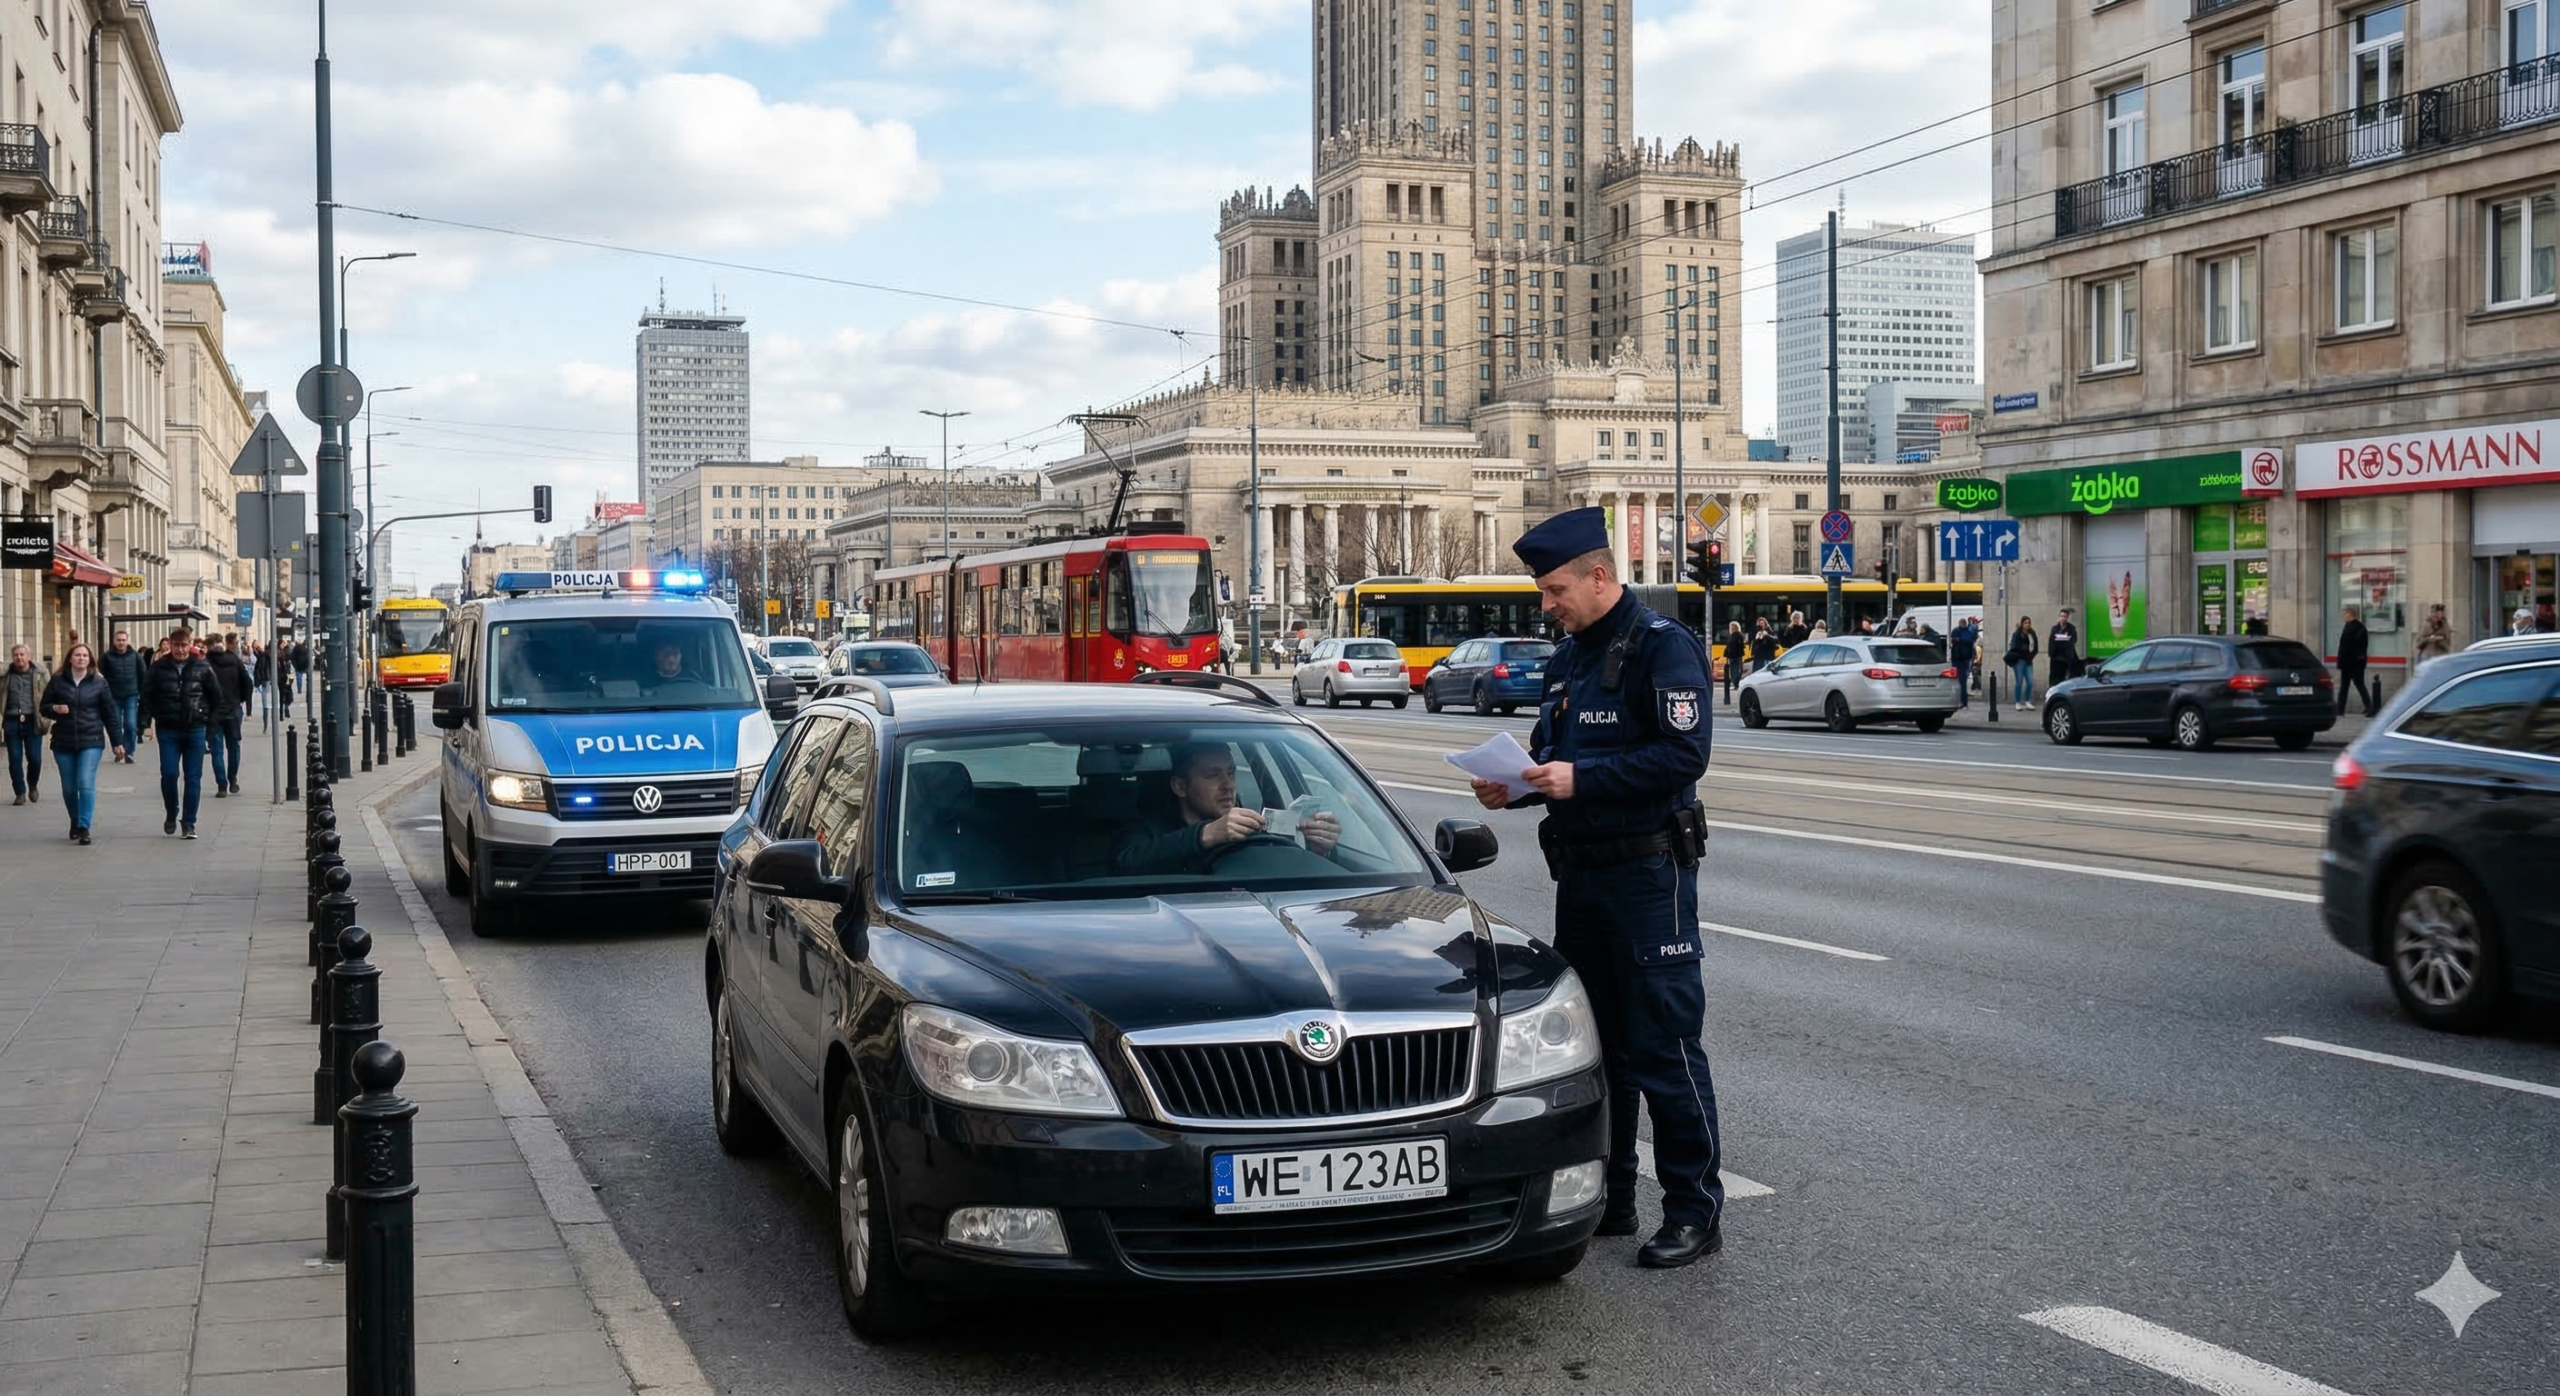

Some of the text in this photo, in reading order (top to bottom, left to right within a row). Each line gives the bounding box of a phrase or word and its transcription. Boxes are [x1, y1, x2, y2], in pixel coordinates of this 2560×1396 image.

[2338, 430, 2541, 480] ROSSMANN
[2071, 472, 2139, 501] żabka
[554, 573, 614, 586] POLICJA
[1579, 711, 1618, 724] POLICJA
[575, 734, 705, 754] POLICJA
[618, 853, 687, 871] HPP-001
[1242, 1145, 1440, 1198] WE 123AB
